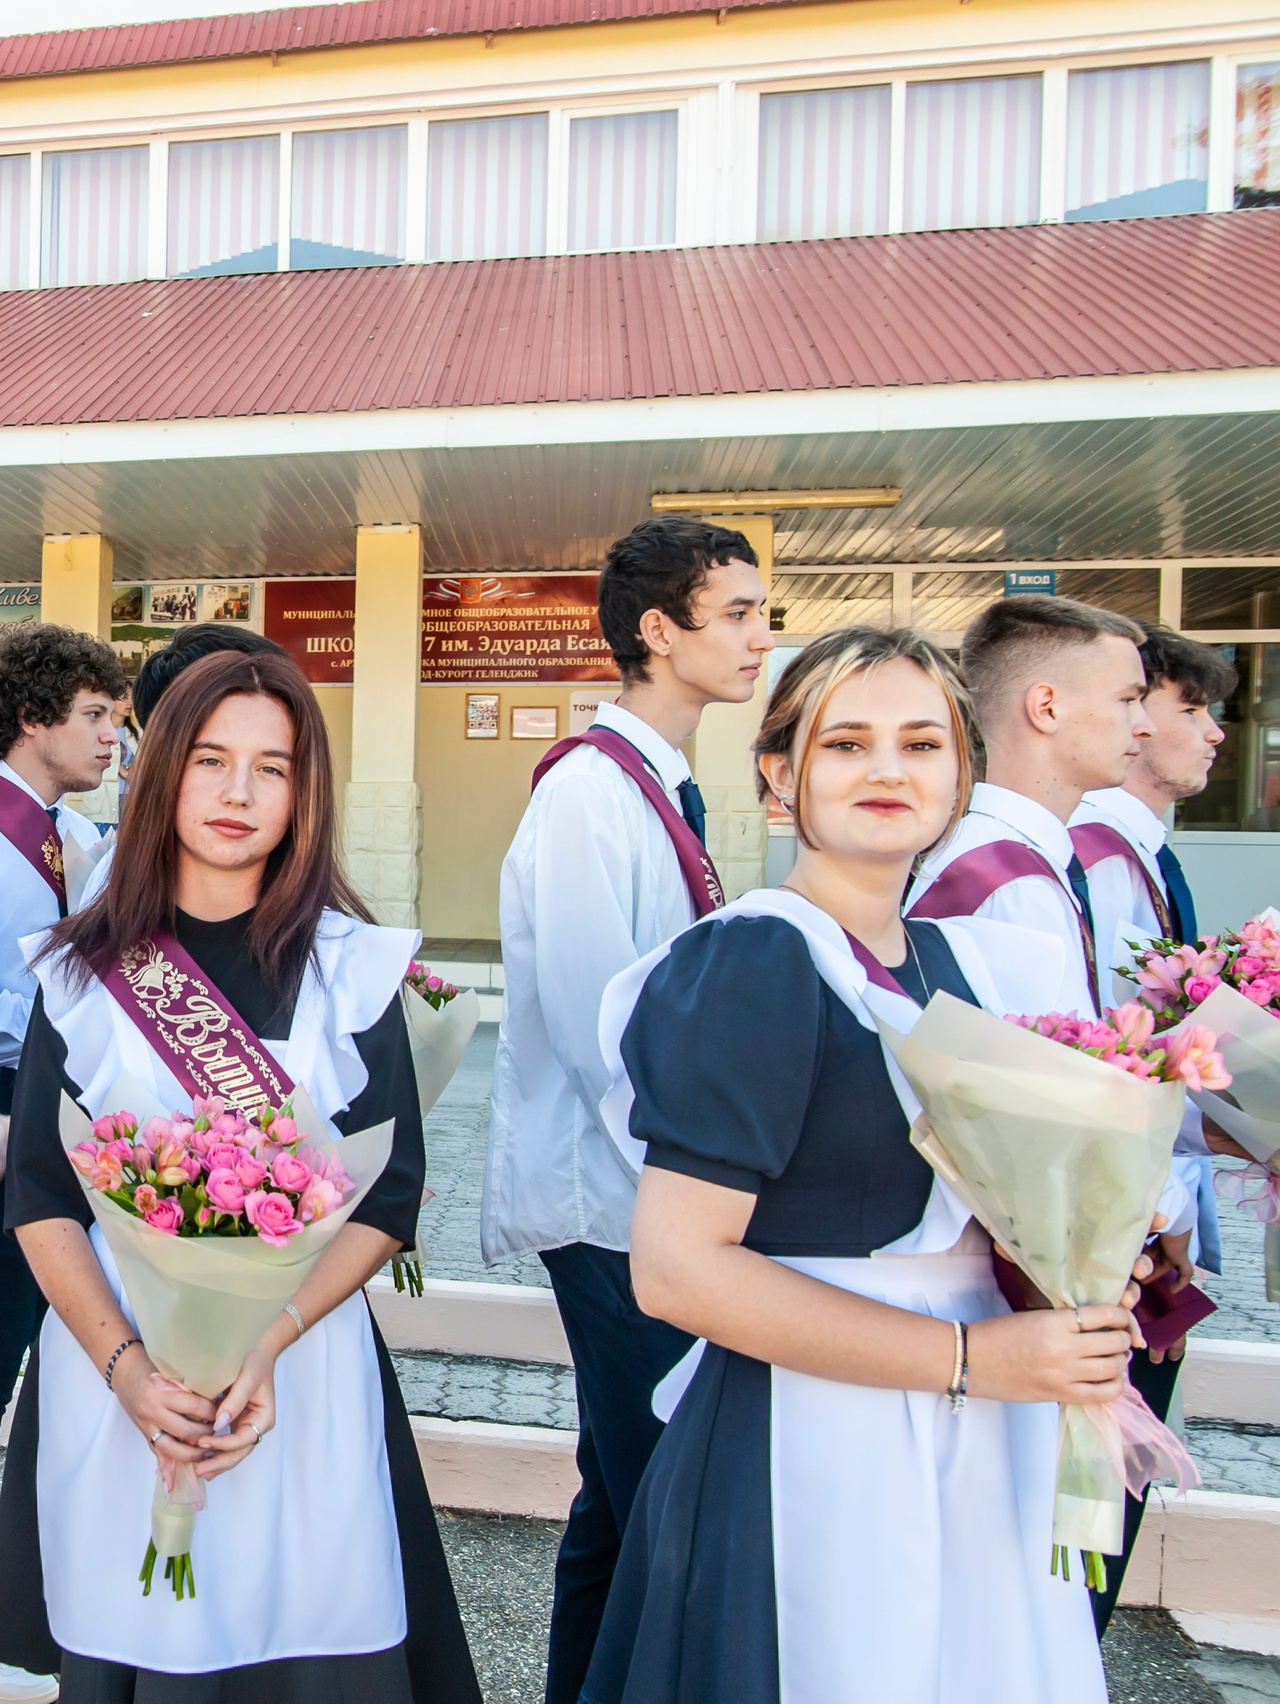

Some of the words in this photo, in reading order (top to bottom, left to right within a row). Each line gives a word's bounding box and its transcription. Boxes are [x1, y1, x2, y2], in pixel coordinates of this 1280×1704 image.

[1010, 573, 1017, 585] 1
[453, 606, 590, 619] ОБЩЕОБРАЗОВАТЕЛЬНОЕ
[306, 637, 355, 653] ШКО
[441, 640, 474, 652] им.
[478, 636, 561, 656] Эдуарда
[340, 659, 354, 668] АР
[420, 658, 436, 668] КА
[438, 657, 537, 669] МУНИЦИПАЛЬНОГО
[538, 656, 613, 667] ОБРАЗОВАНИЯ
[476, 668, 540, 679] ГЕЛЕНДЖИК
